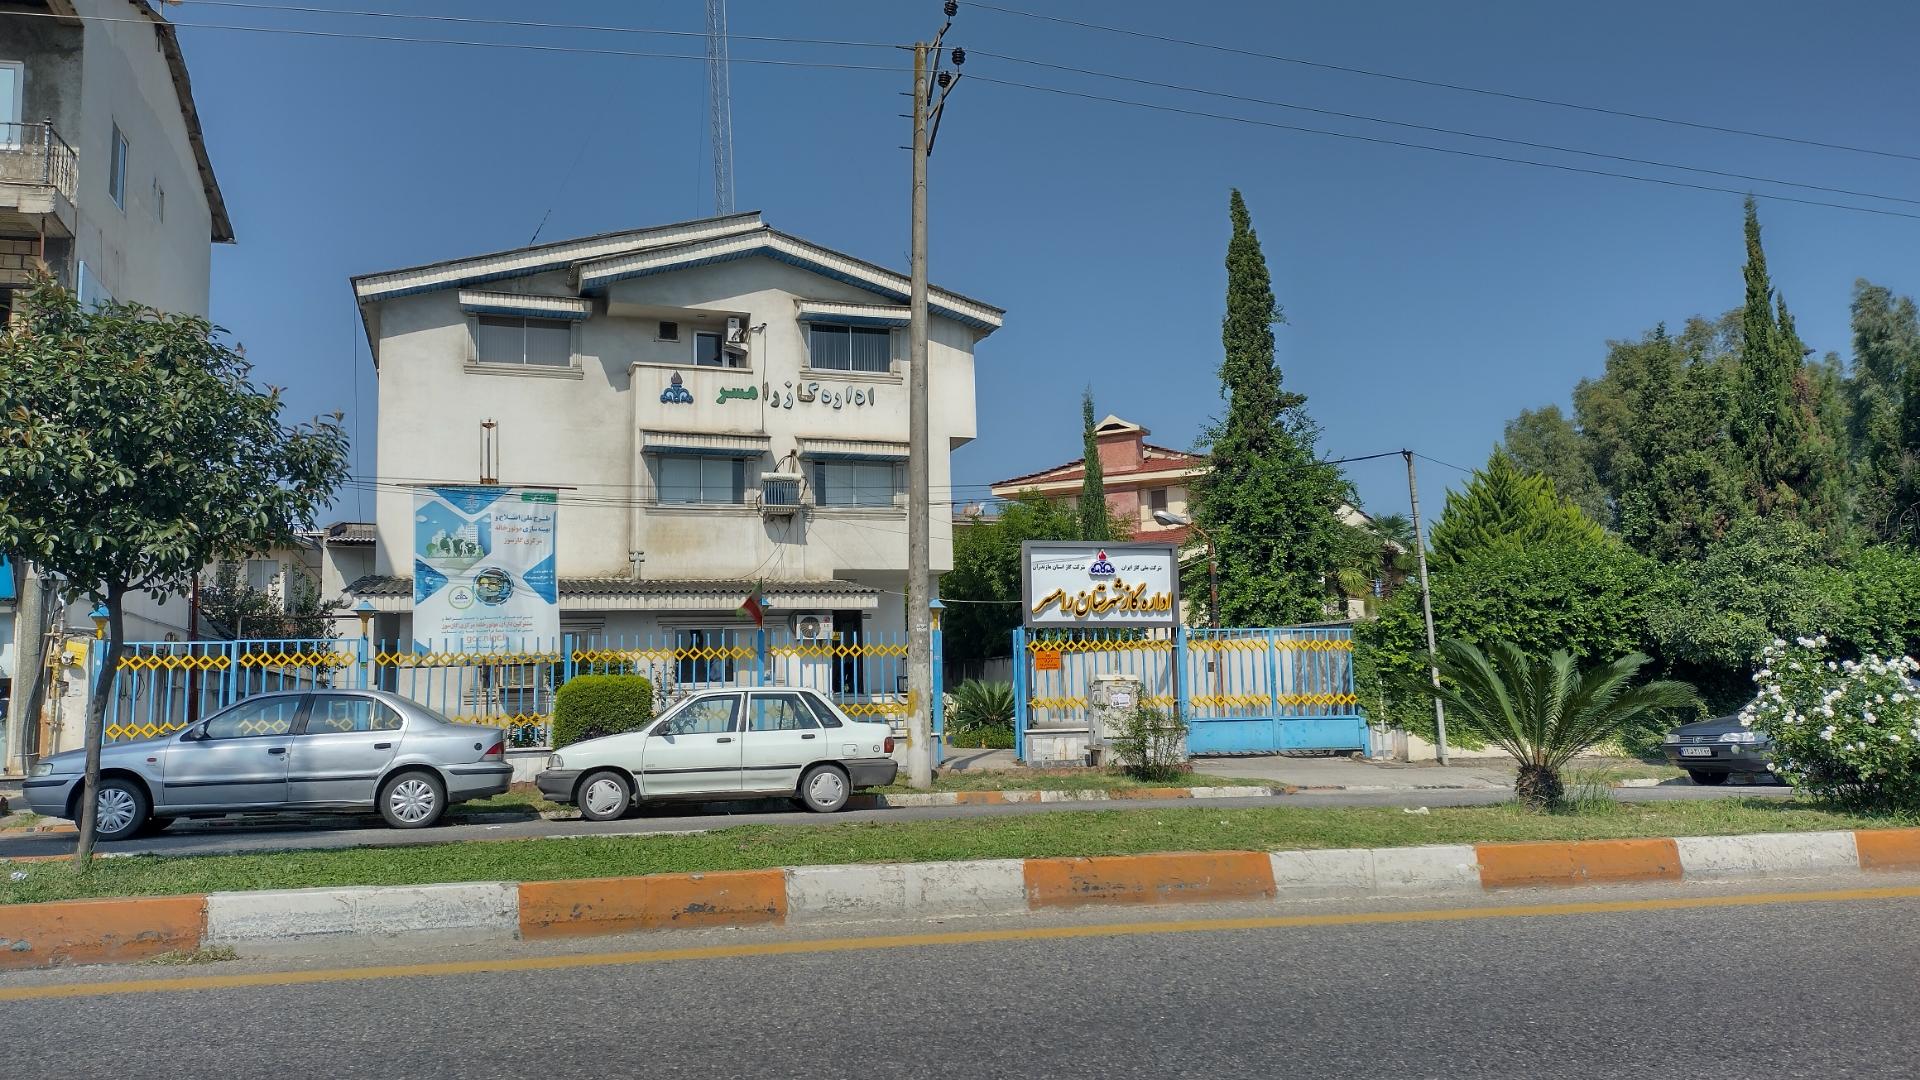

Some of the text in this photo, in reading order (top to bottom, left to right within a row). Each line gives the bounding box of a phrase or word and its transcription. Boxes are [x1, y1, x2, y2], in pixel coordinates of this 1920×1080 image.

[715, 380, 875, 410] اداره گاز رامسر
[1032, 563, 1052, 571] مازندران
[1053, 563, 1065, 571] استان
[1072, 563, 1086, 571] شرکت
[1120, 564, 1132, 572] ایران
[1140, 564, 1149, 572] ملی
[1149, 564, 1162, 572] شرکت
[1031, 577, 1173, 617] اداره گاز شهرستان رامسر
